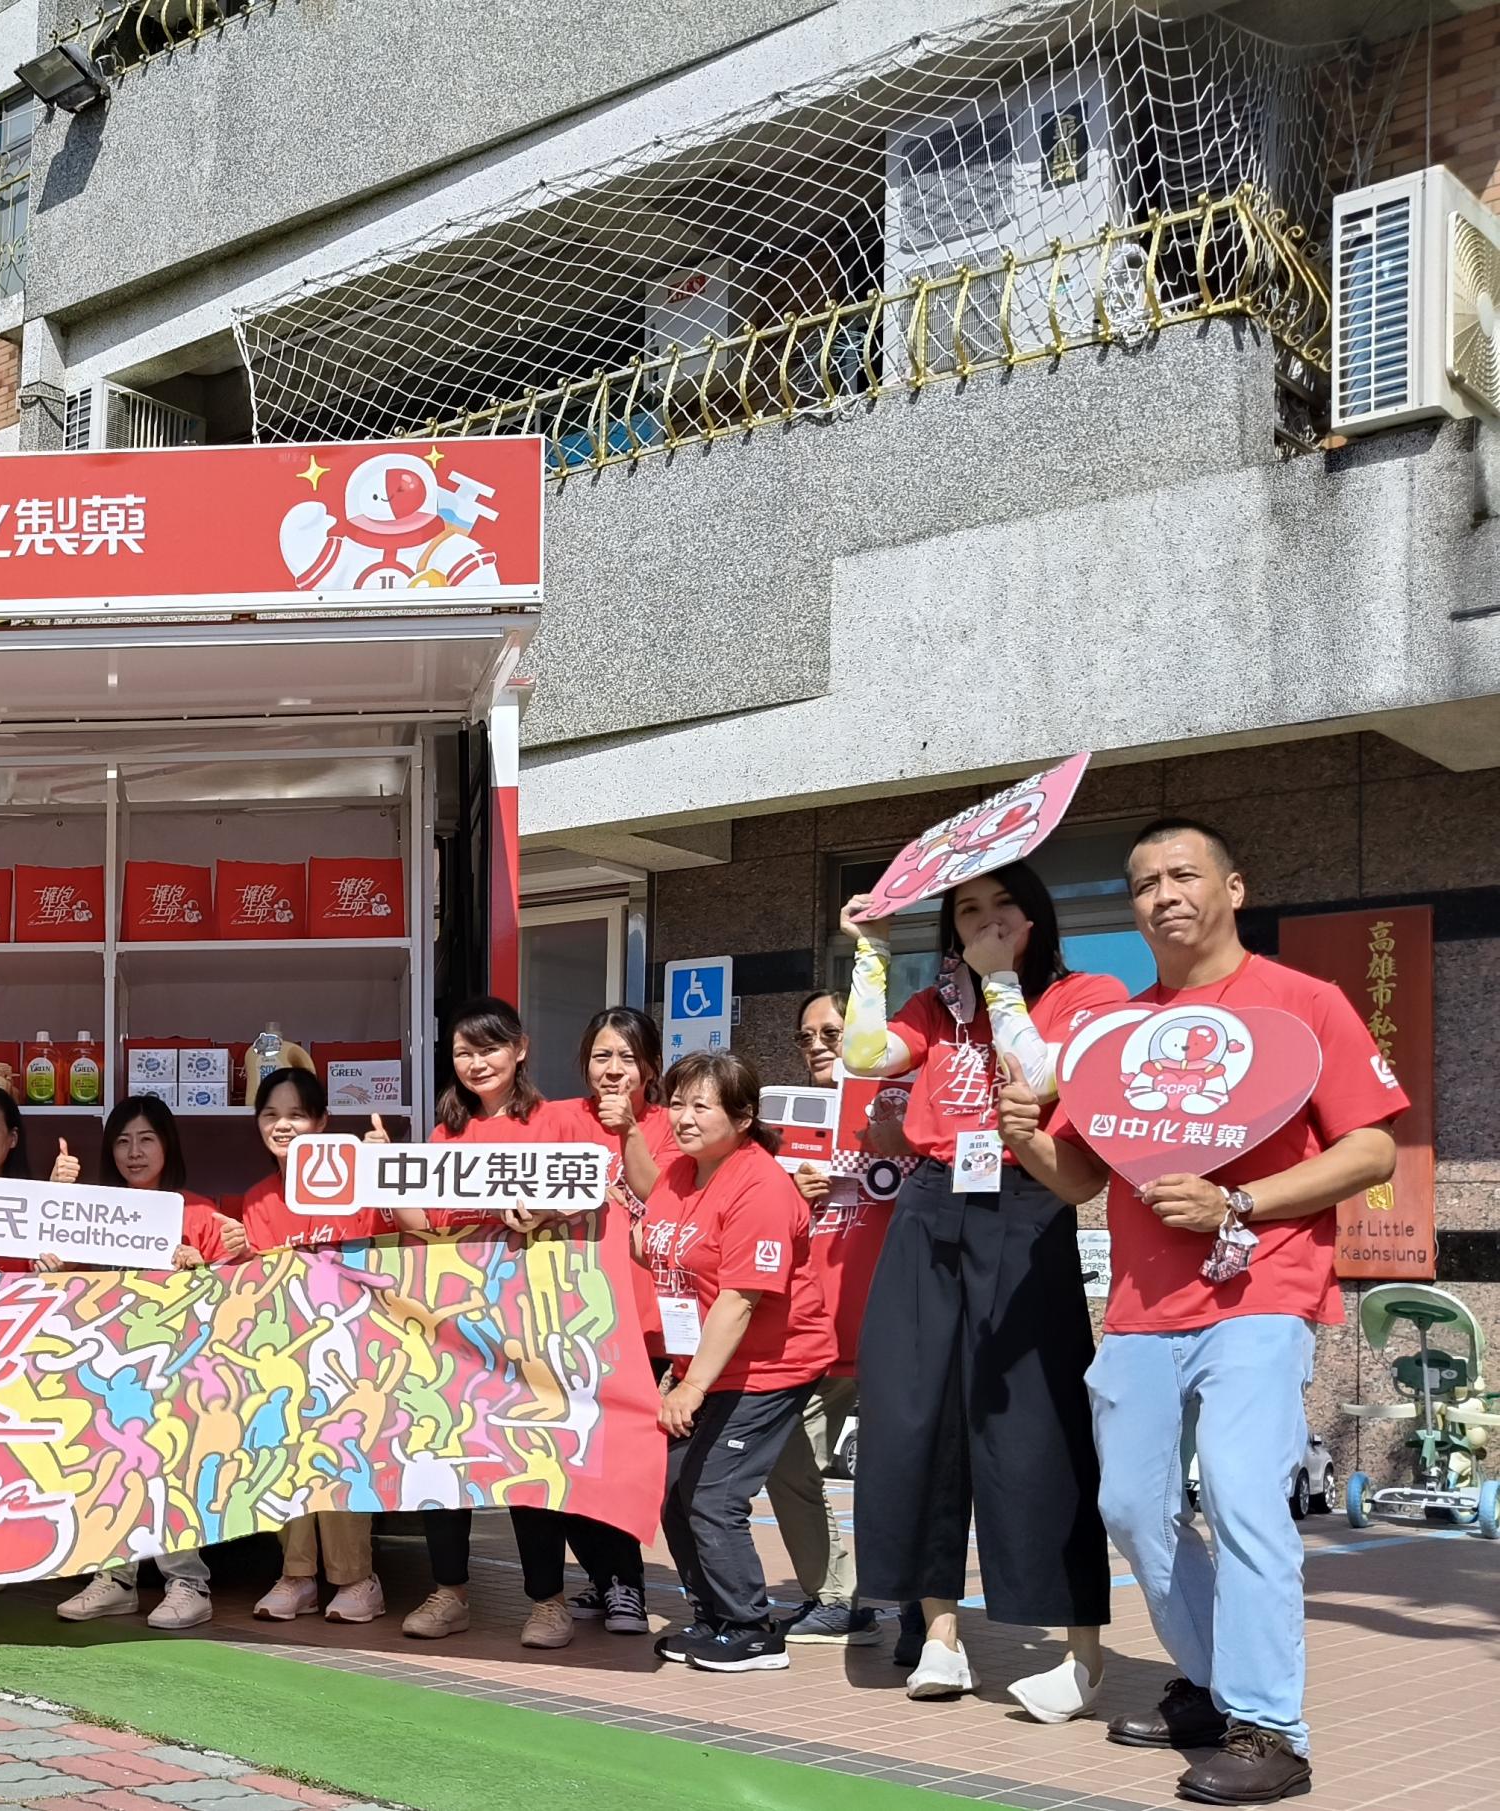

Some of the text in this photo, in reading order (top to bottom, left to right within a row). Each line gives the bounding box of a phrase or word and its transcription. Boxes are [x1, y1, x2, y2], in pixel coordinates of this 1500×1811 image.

[331, 1069, 362, 1077] GREEN
[1156, 1083, 1198, 1095] CCPG
[1119, 1117, 1248, 1149] 中化製藥
[377, 1150, 600, 1200] 中化製藥
[38, 1223, 169, 1252] Healthcare
[1347, 1220, 1363, 1237] of
[1367, 1221, 1415, 1237] Little
[1340, 1244, 1427, 1264] Kaohsiung
